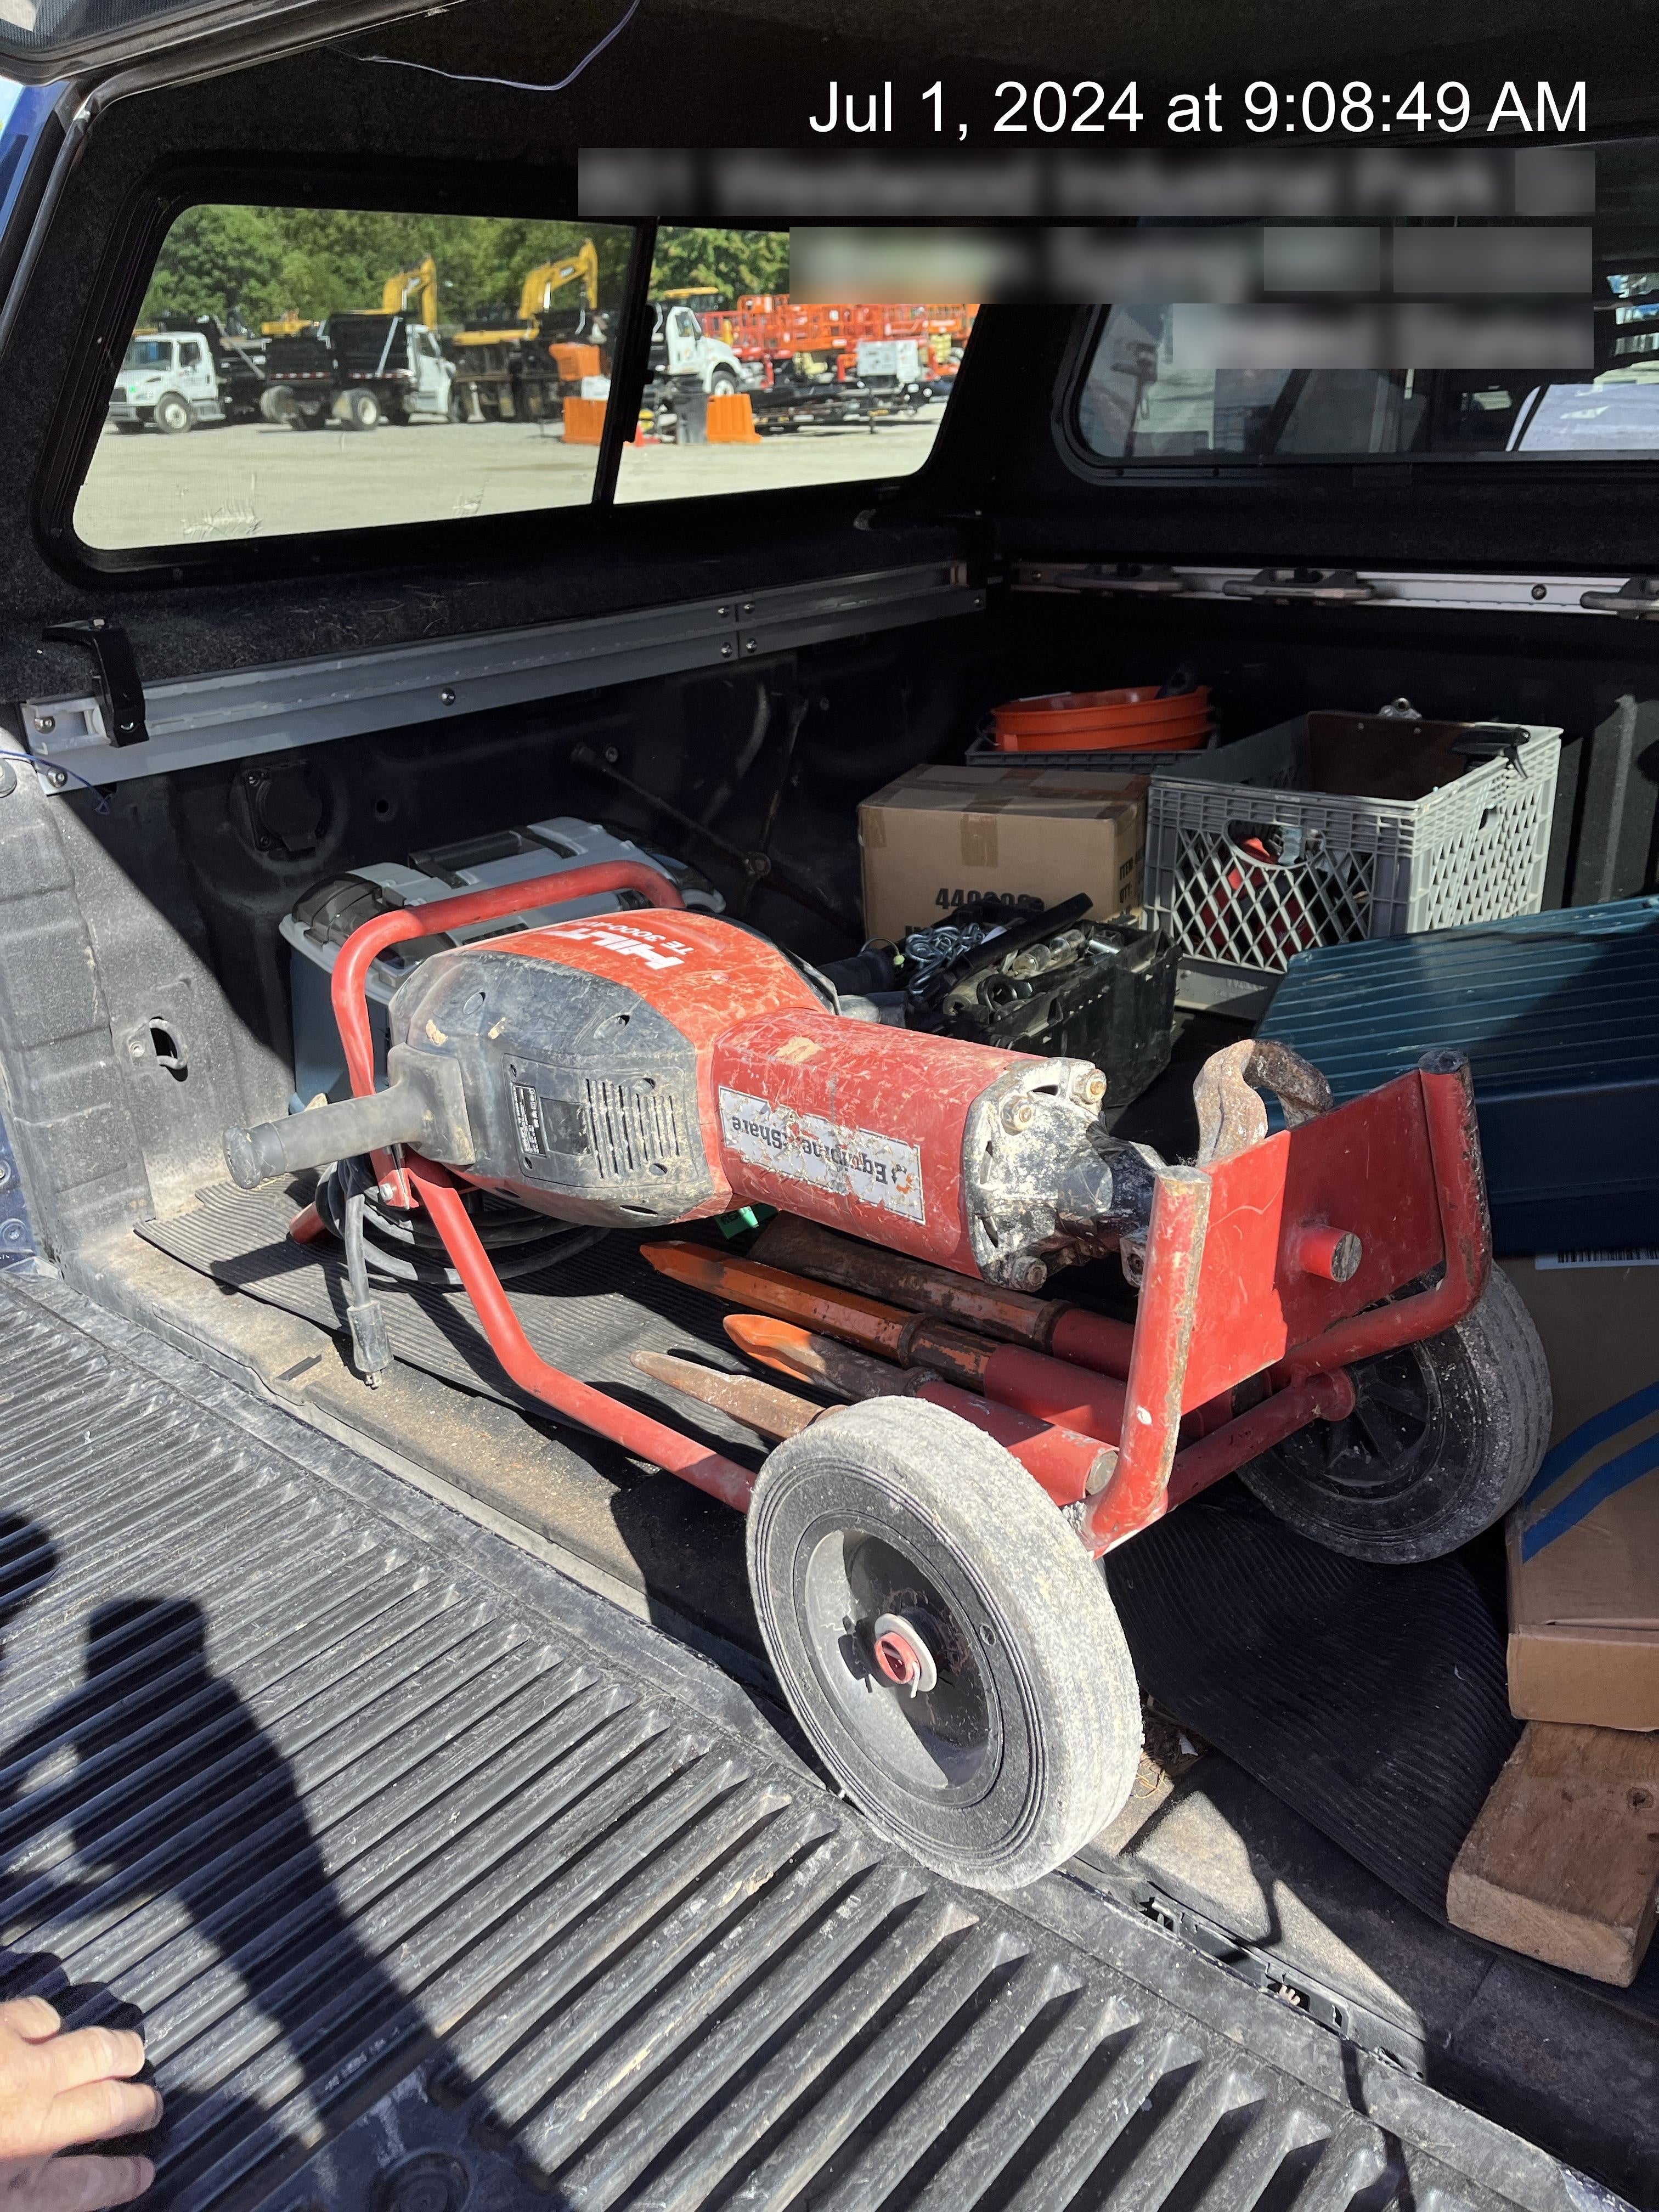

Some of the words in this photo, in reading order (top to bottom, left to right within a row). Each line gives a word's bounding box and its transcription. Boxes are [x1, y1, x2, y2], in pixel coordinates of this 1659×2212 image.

[540, 927, 685, 970] HILT
[660, 940, 695, 956] TE
[732, 1115, 889, 1186] EquipmeShare
